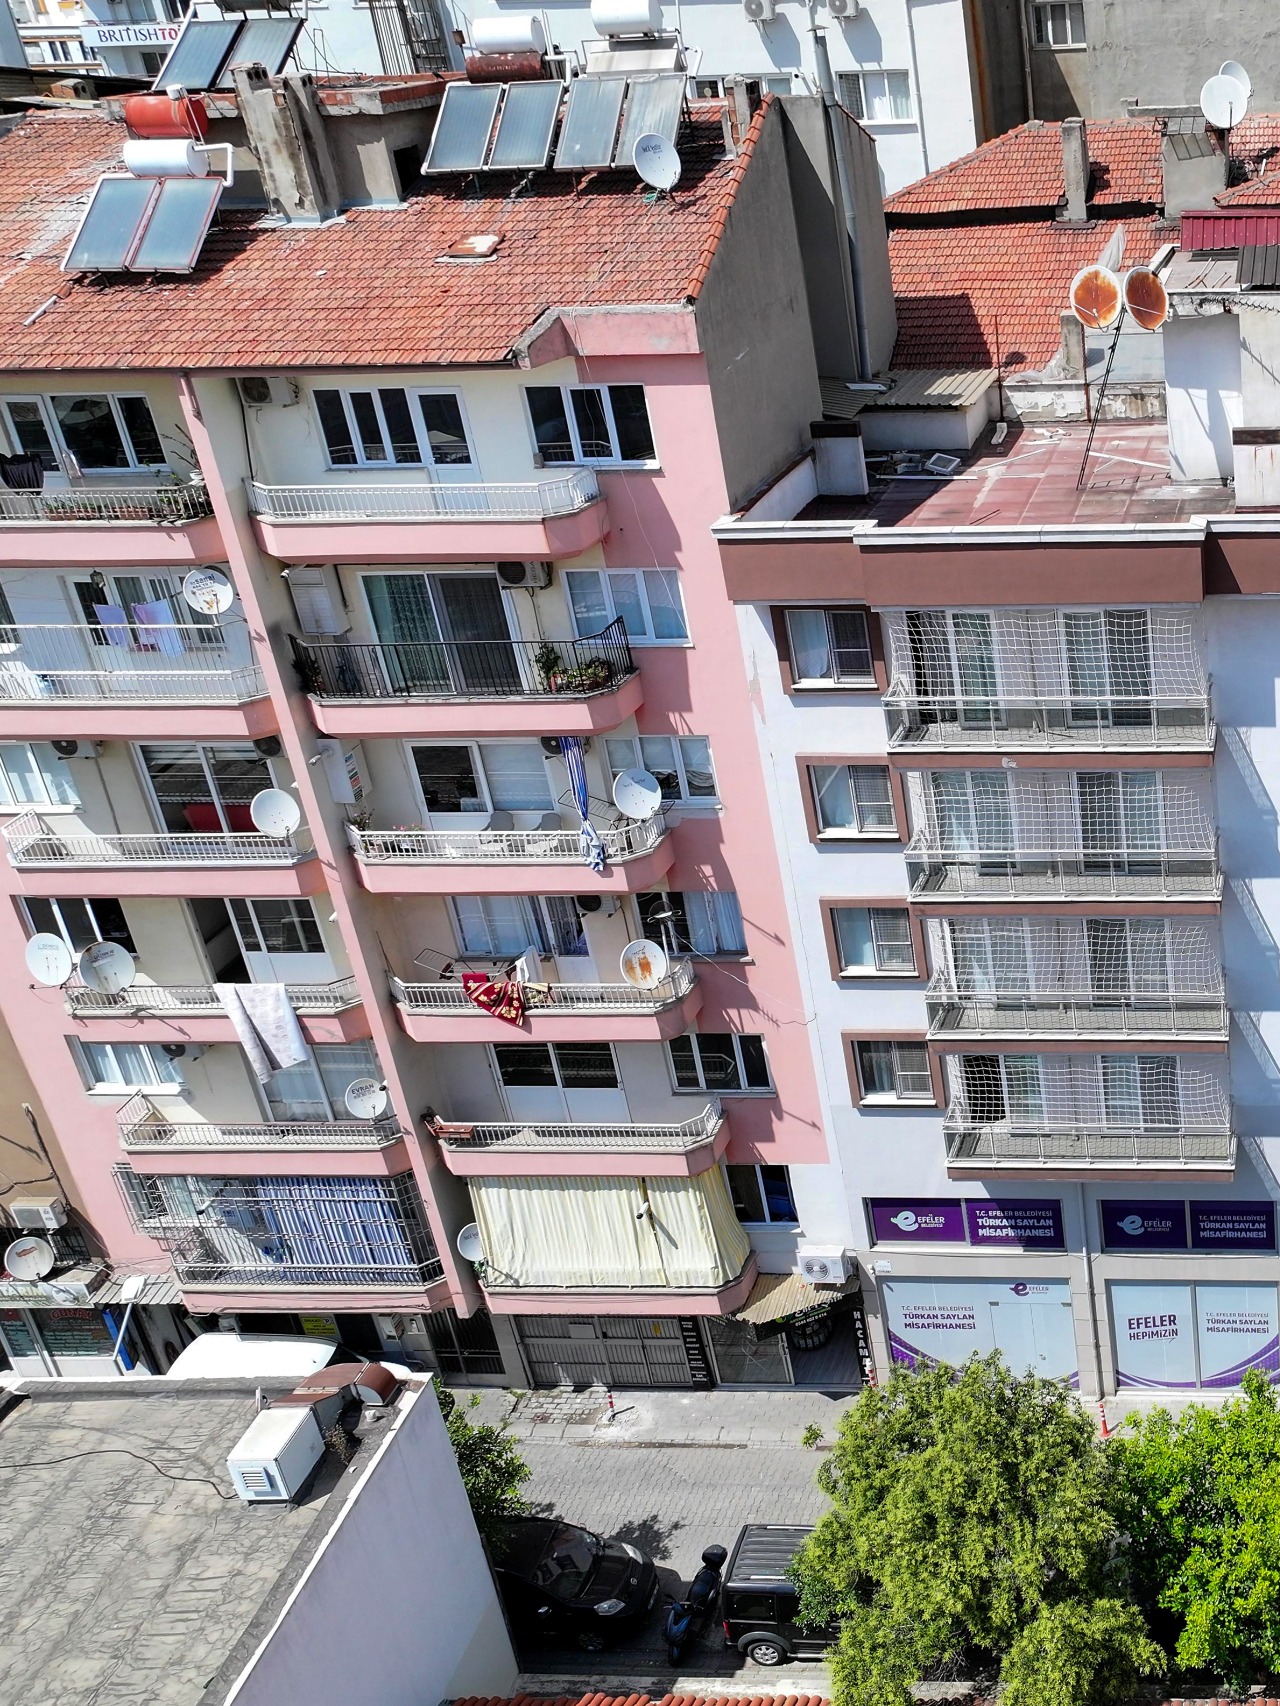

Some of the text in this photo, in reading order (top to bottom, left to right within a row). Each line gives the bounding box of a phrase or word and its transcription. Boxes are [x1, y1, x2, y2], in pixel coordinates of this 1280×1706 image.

[98, 25, 181, 42] BRITISHTO
[977, 1218, 1053, 1226] TÜRKAN SAYLAN
[978, 1227, 1054, 1237] MİSAFİRHANESİ
[1200, 1230, 1266, 1238] MİSAFİRHANESİ
[903, 1312, 939, 1320] TÜRKAN
[904, 1321, 976, 1329] MİSAFİRHANESİ
[1128, 1314, 1177, 1330] EFELER
[1129, 1328, 1178, 1341] HEPİMİZİN
